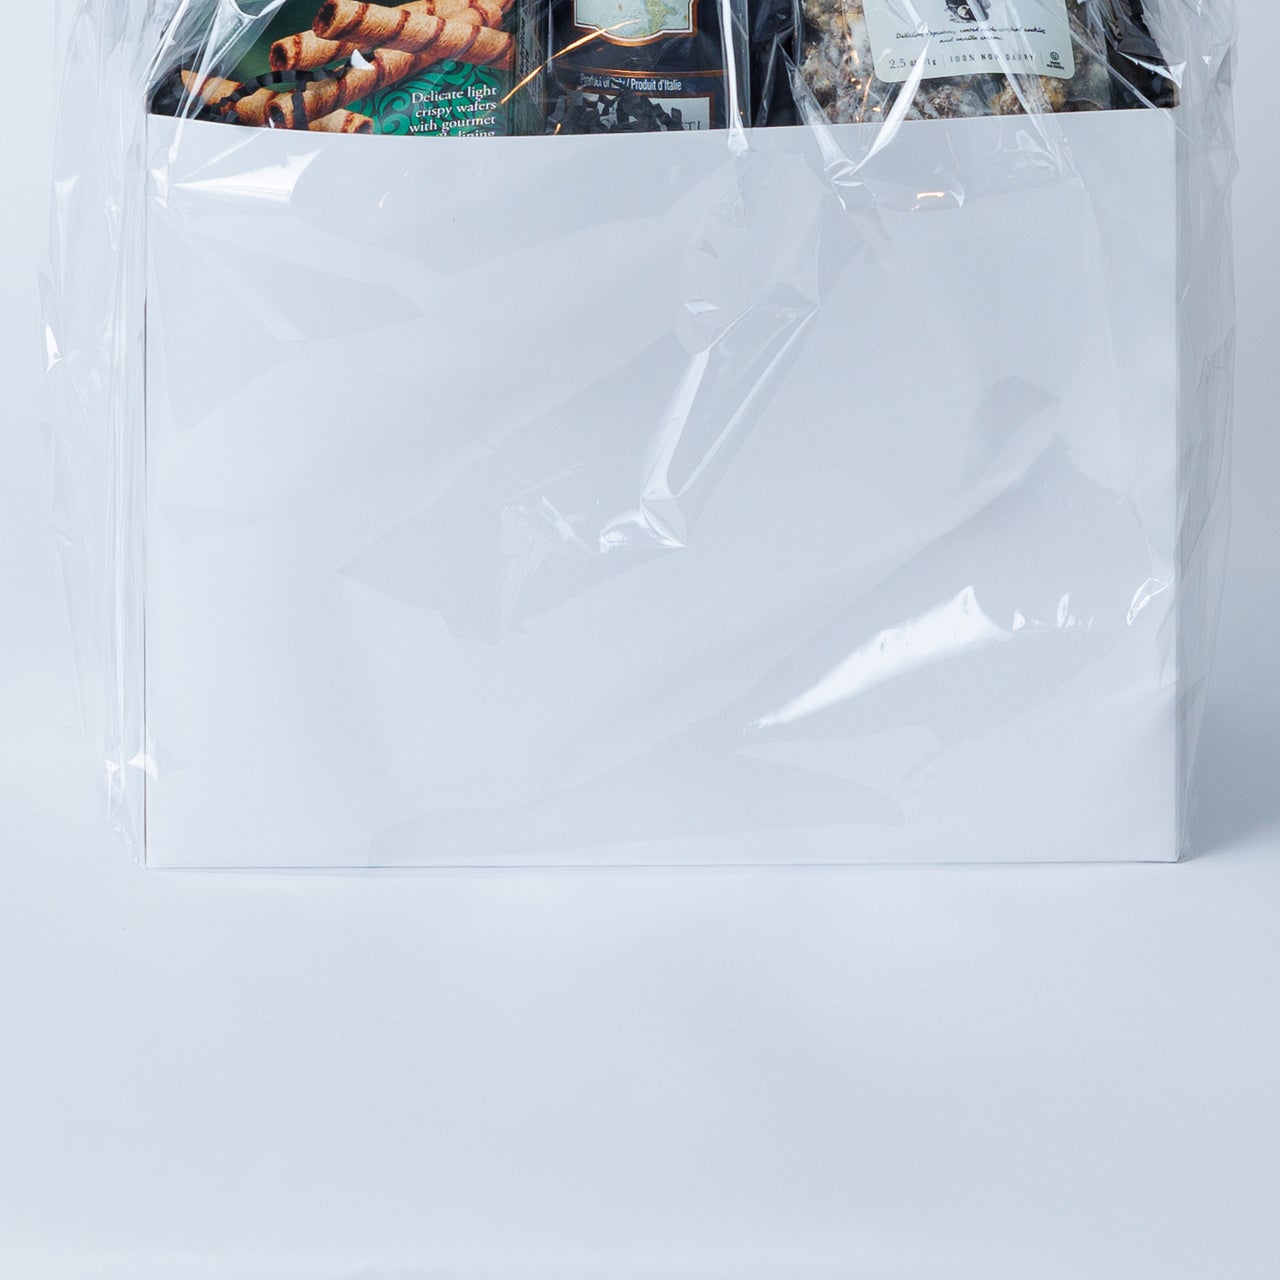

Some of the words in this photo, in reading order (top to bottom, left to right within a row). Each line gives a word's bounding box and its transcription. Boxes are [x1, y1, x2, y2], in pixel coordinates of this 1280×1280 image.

[888, 57, 907, 69] 2.5
[949, 54, 975, 63] 100%
[631, 78, 657, 91] Produit
[657, 78, 682, 91] d'Italie
[412, 90, 464, 104] Delicate
[467, 84, 497, 101] light
[415, 105, 453, 118] crispy
[456, 100, 497, 113] wafers
[409, 119, 438, 133] with
[441, 116, 496, 133] gourmet
